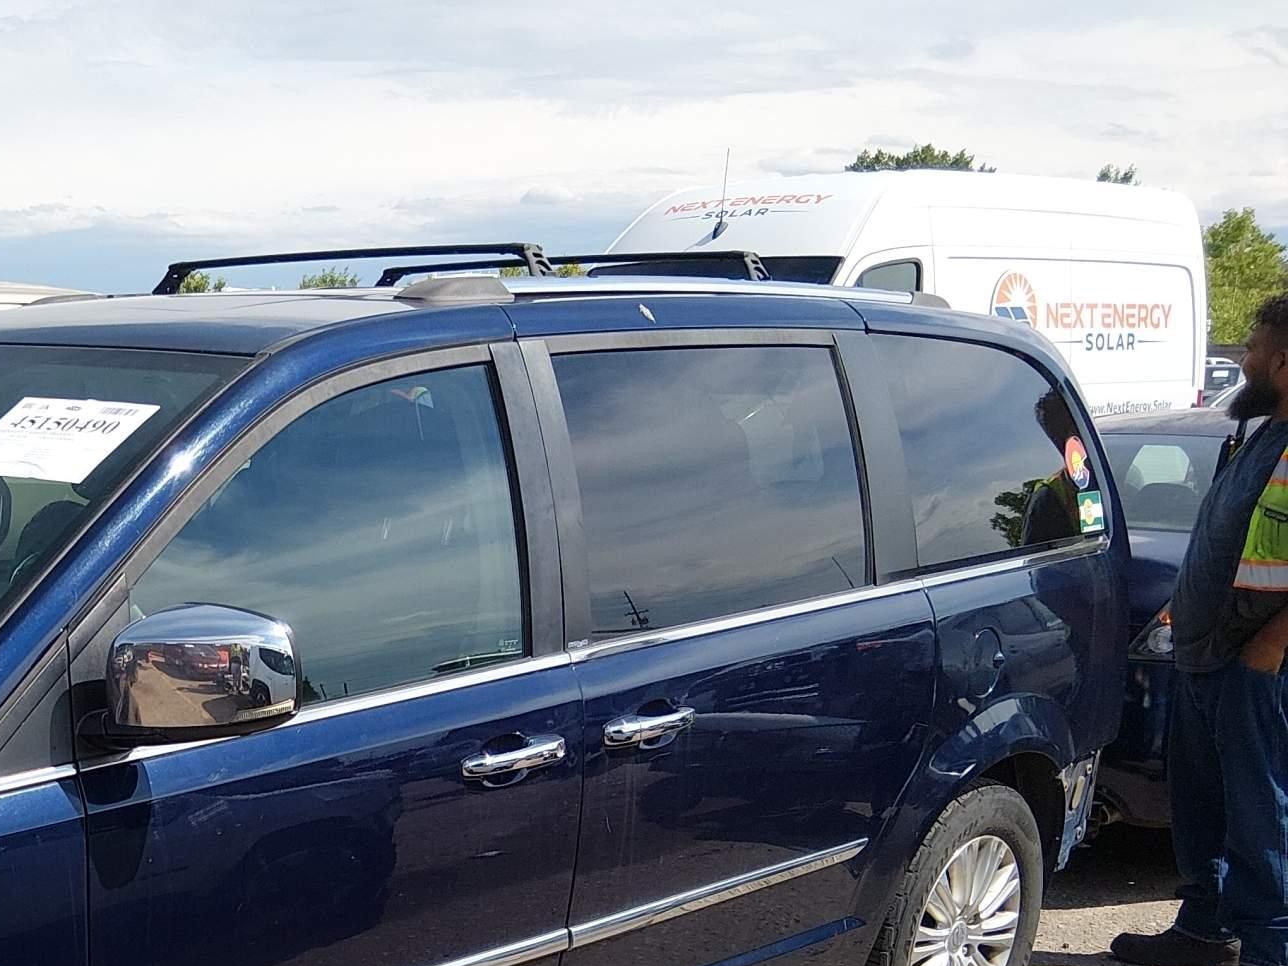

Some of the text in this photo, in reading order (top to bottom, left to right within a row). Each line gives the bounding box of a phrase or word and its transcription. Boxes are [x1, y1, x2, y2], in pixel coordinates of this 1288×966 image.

[701, 207, 769, 220] SOLAR
[1085, 333, 1135, 351] SOLAR
[9, 415, 121, 434] 45150490
